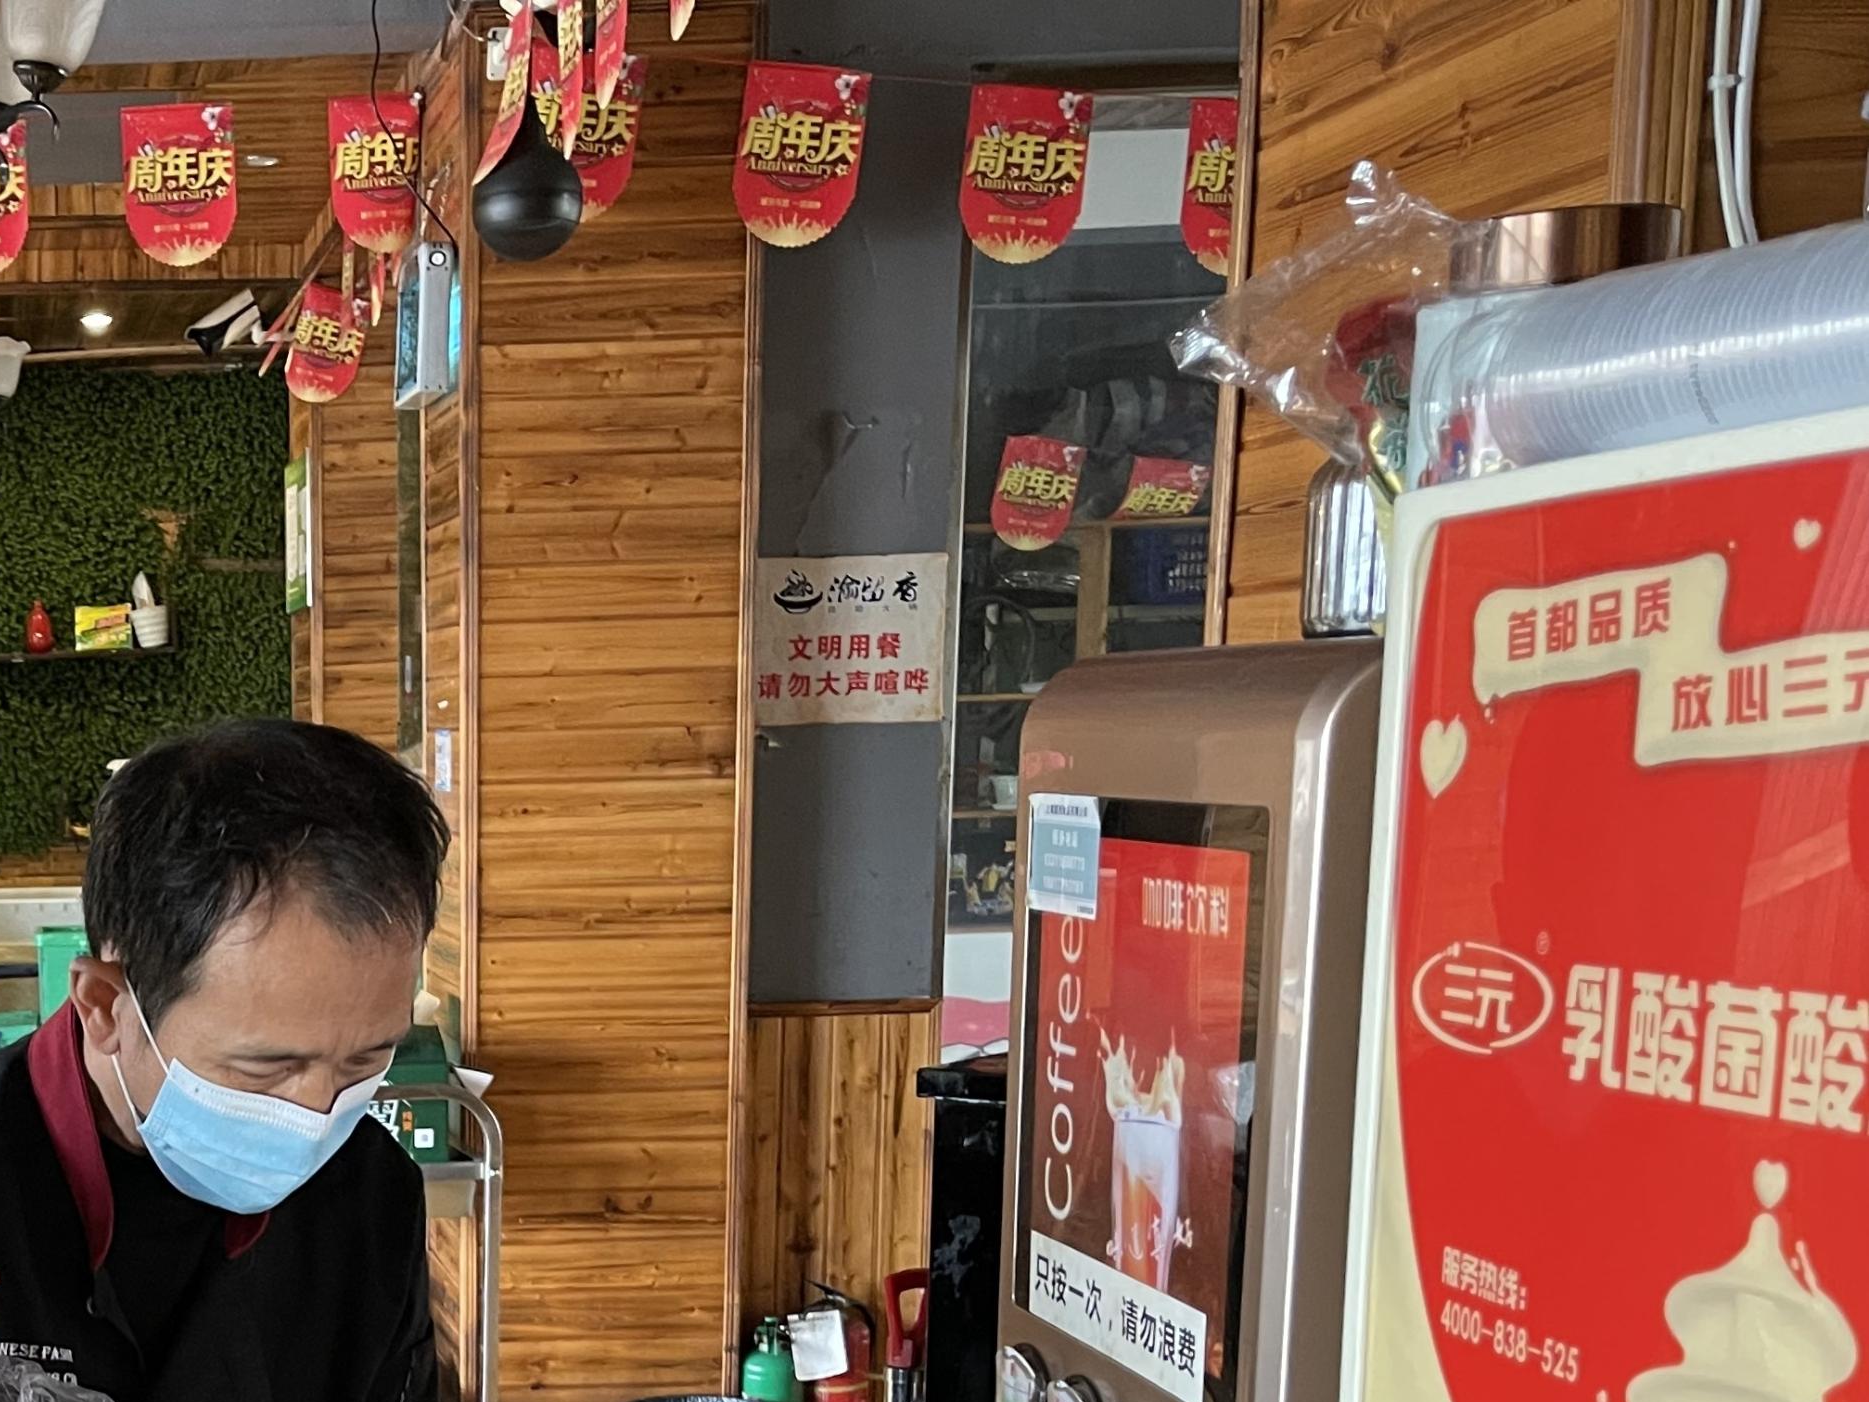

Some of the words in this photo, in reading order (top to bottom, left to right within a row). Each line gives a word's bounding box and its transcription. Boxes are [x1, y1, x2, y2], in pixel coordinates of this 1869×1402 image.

[741, 112, 862, 163] 周年庆
[966, 132, 1086, 182] 周年庆
[128, 147, 233, 194] 周年庆
[746, 156, 832, 178] Anniversary
[972, 176, 1058, 197] Anniversary
[137, 187, 214, 203] Anniversary
[295, 315, 365, 357] 周年庆
[999, 466, 1077, 501] 周年庆
[1507, 577, 1672, 662] 首都品质
[788, 632, 901, 662] 文明用餐
[758, 668, 930, 700] 请勿大声喧哗
[1142, 876, 1229, 939] 咖啡饮料
[1440, 963, 1514, 1034] 三元
[1044, 915, 1084, 1221] Coffee
[1440, 1299, 1579, 1383] 4000-838-525
